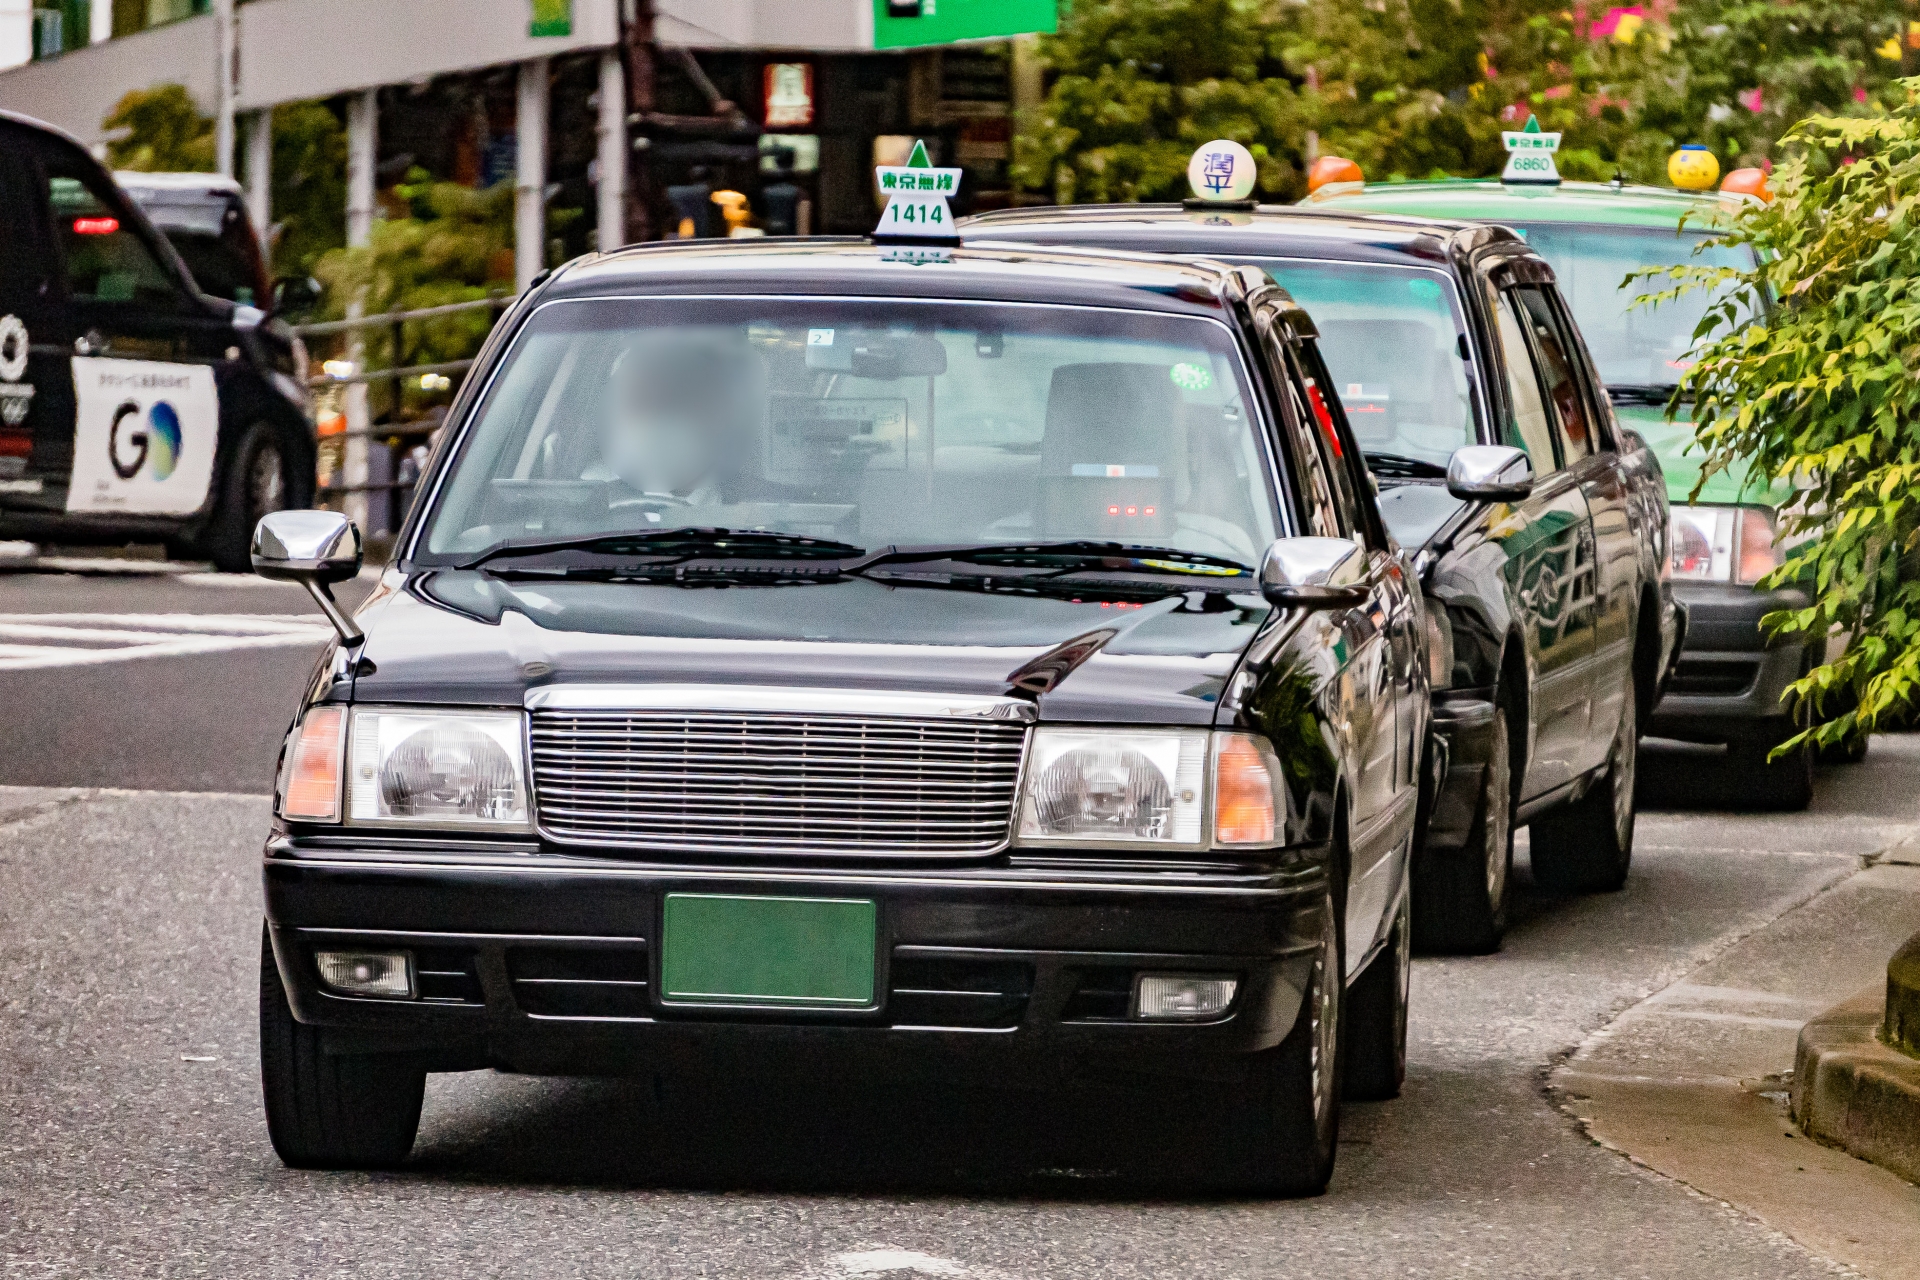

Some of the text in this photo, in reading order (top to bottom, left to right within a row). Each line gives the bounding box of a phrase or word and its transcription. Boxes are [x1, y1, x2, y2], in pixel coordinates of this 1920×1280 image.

[1513, 157, 1549, 171] 6860
[882, 172, 953, 190] 東京無線
[891, 204, 943, 224] 1414
